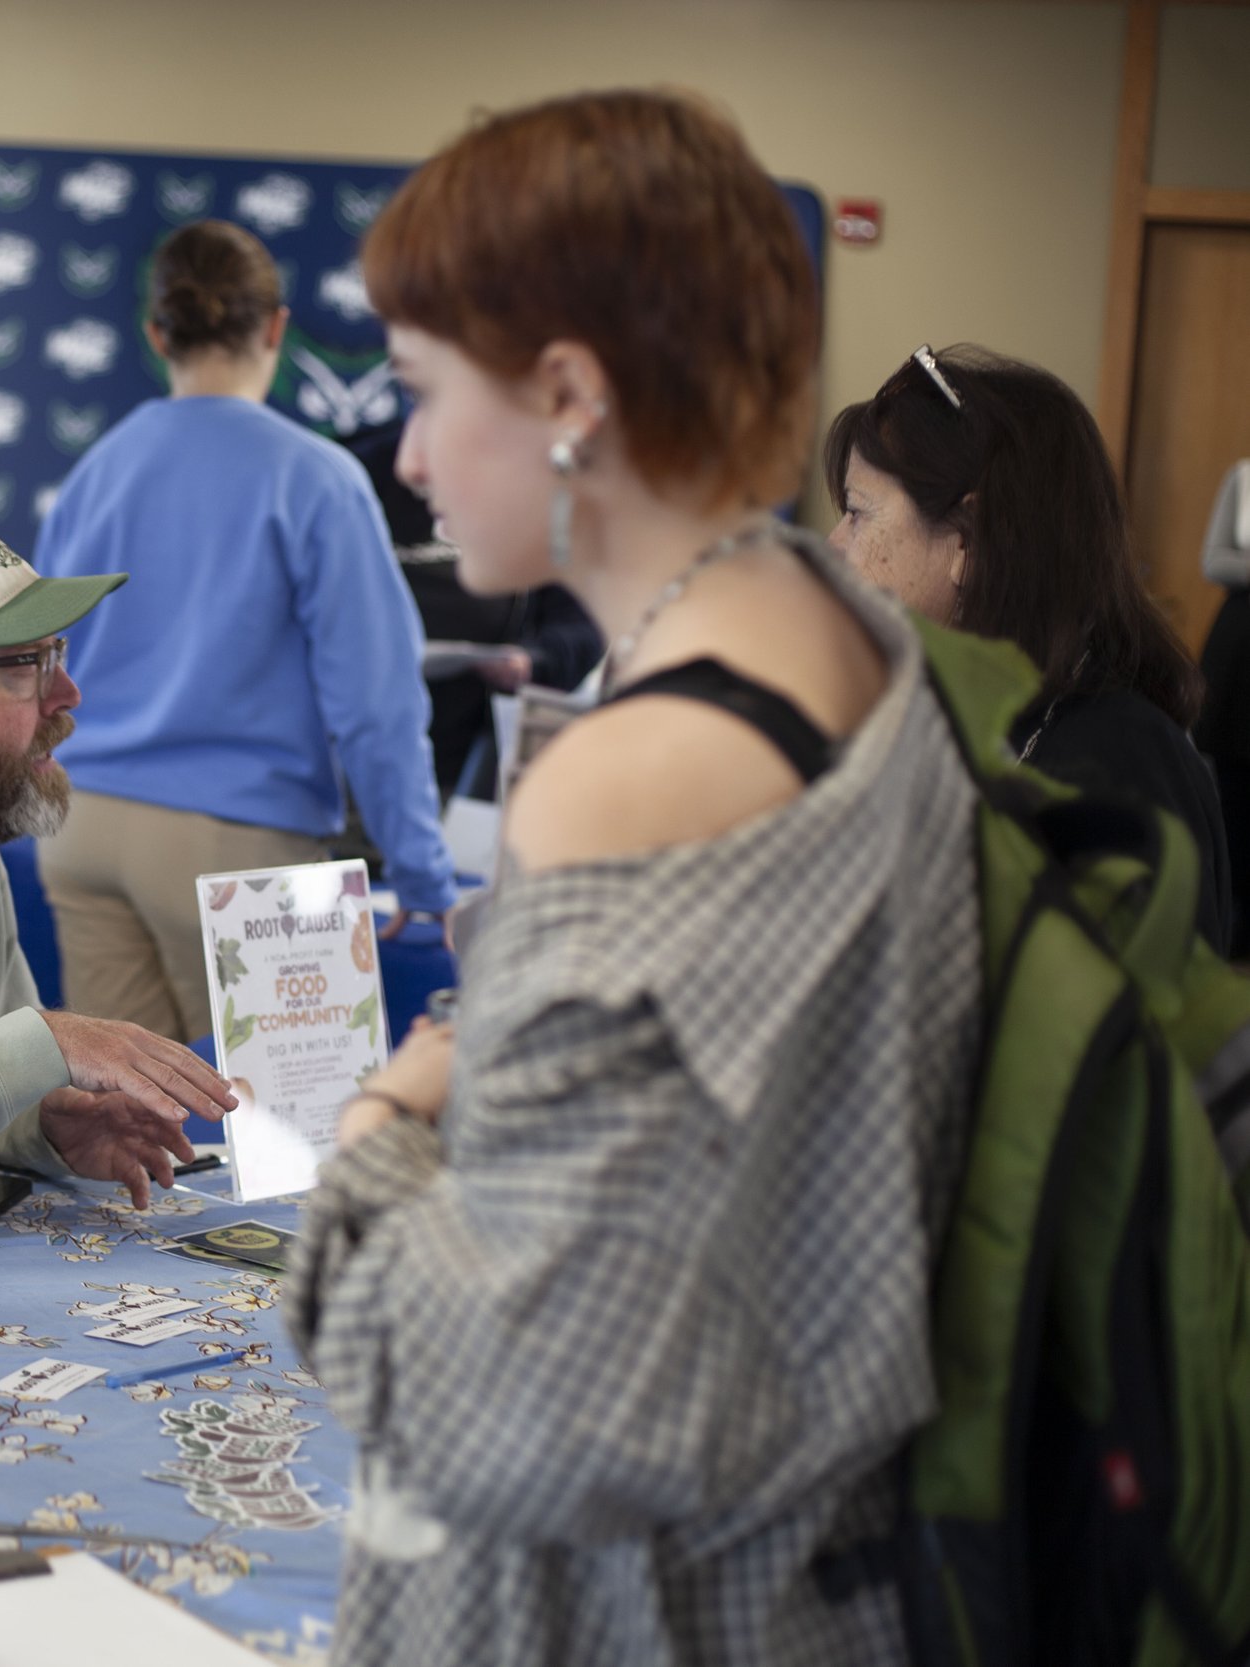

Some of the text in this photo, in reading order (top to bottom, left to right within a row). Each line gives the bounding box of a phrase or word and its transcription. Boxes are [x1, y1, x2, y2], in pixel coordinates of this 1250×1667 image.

[244, 910, 346, 941] ROOT CAUSE!
[278, 962, 321, 976] GROWING
[275, 974, 327, 999] FOOD
[258, 1004, 352, 1032] COMMUNITY
[305, 1038, 330, 1051] WITH
